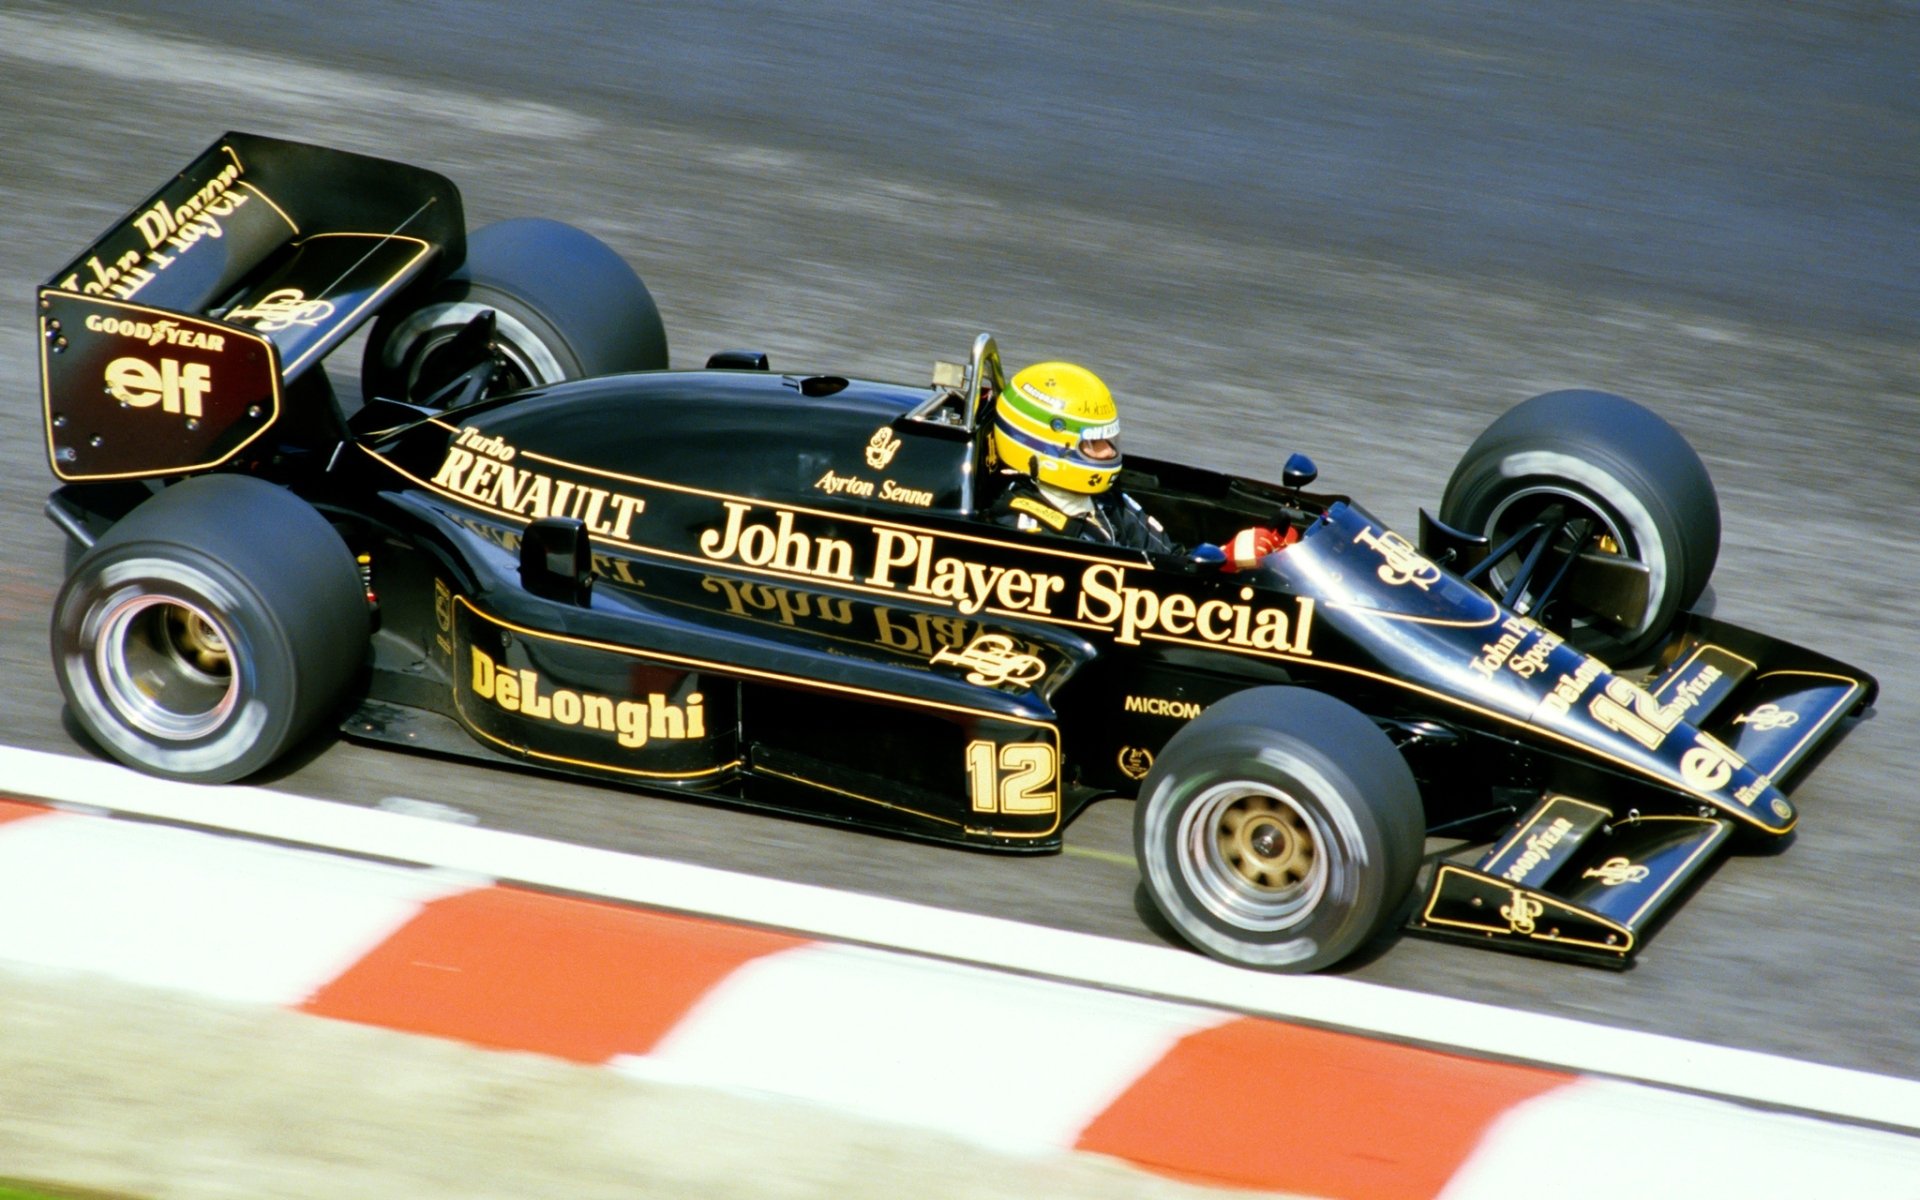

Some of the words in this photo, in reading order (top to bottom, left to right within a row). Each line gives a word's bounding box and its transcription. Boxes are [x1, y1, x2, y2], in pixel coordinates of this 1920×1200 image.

[85, 314, 225, 352] GOODYEAR
[104, 356, 211, 417] elf
[455, 426, 516, 461] Turbo
[430, 446, 645, 540] RENAULT
[814, 470, 875, 496] Ayrton
[878, 479, 933, 507] Senna
[701, 502, 853, 581] John
[865, 525, 1065, 614] Player
[1077, 565, 1315, 656] Special
[472, 644, 706, 748] DeLonghi
[1124, 695, 1201, 719] MICROM
[1588, 675, 1685, 751] 12
[965, 741, 1057, 816] 12
[1680, 731, 1747, 792] el
